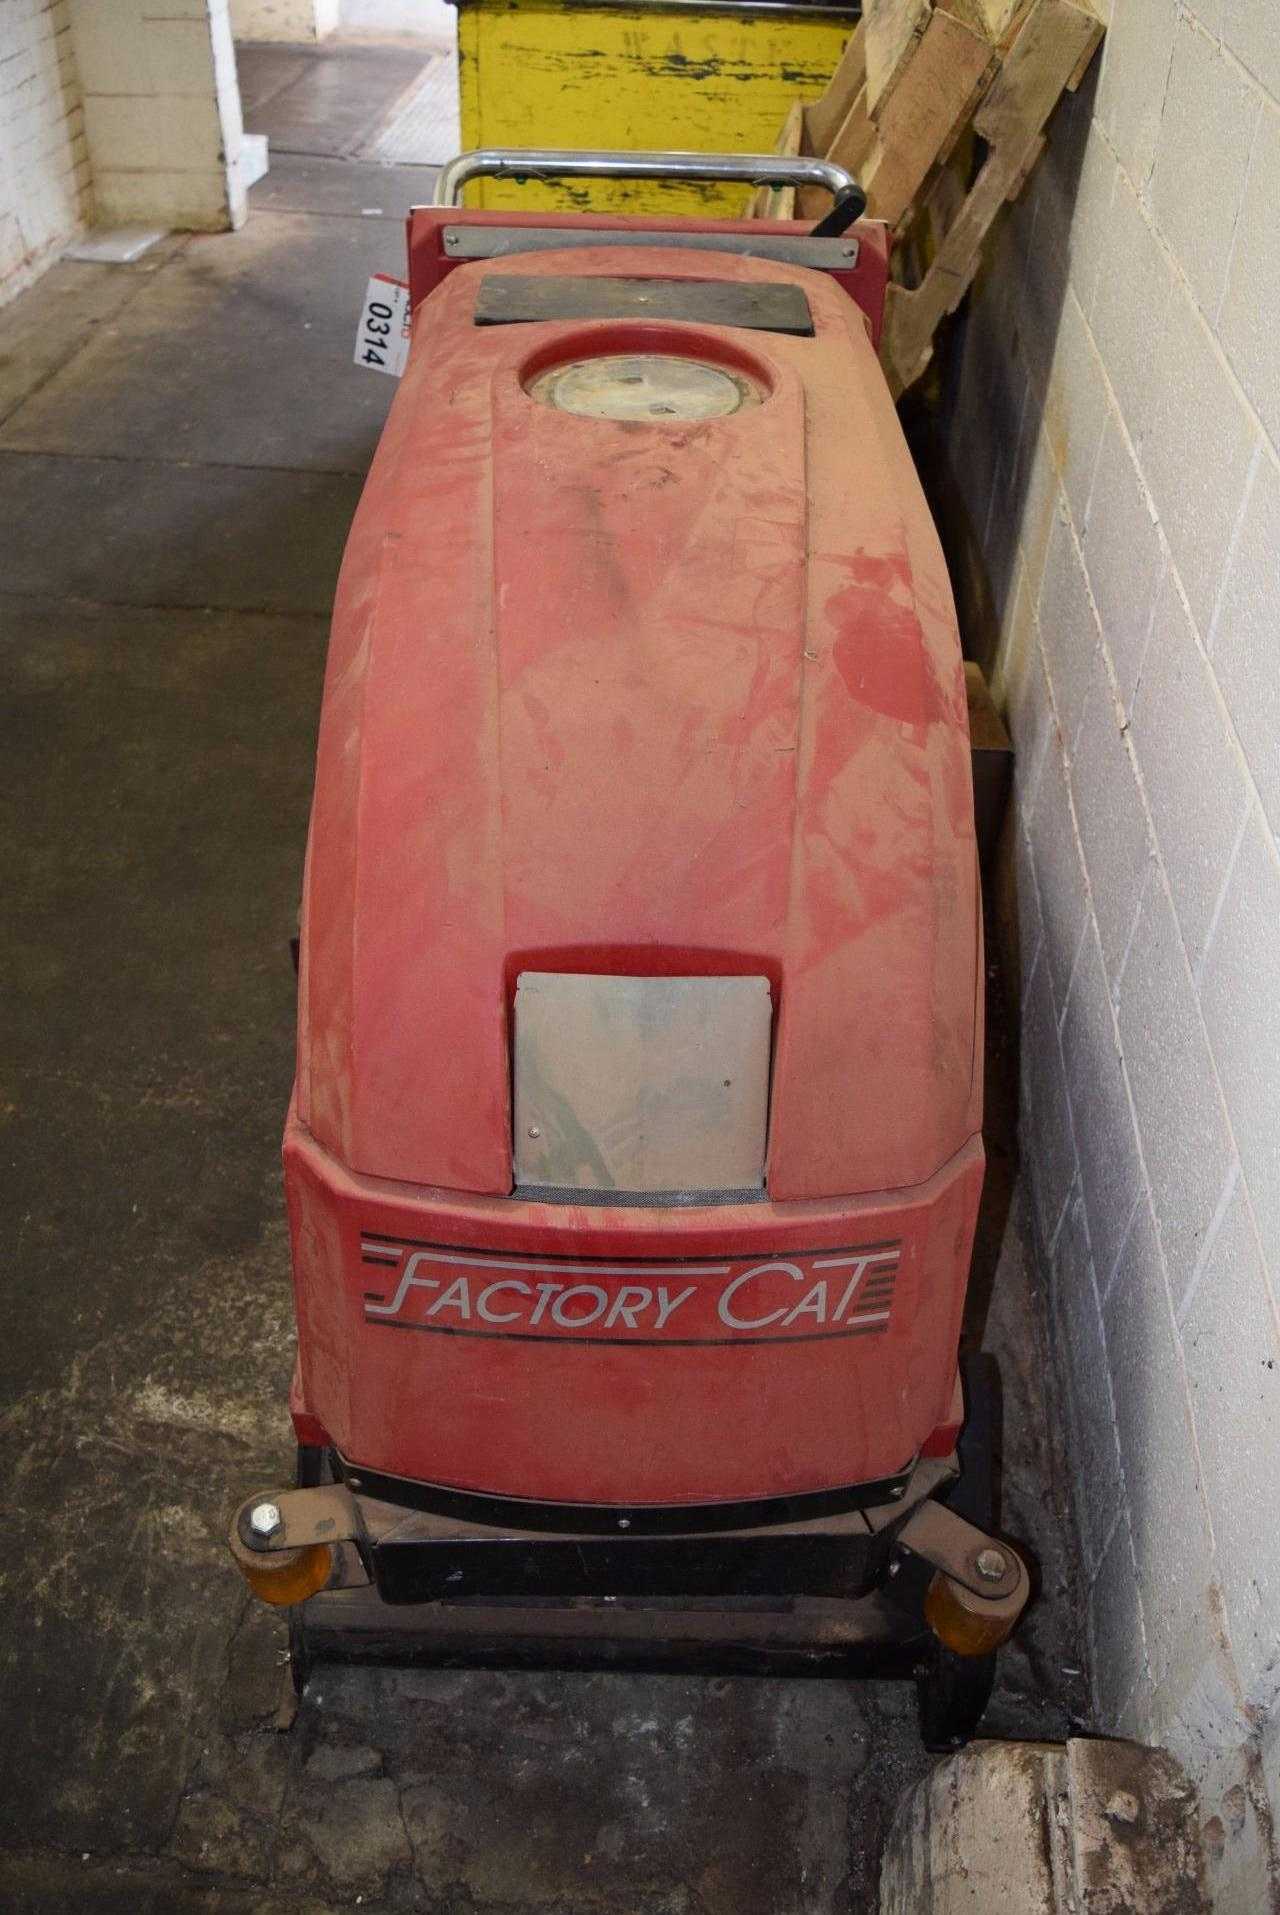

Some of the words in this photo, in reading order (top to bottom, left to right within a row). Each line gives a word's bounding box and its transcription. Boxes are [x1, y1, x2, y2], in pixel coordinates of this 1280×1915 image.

[362, 302, 393, 365] 0314
[364, 1252, 730, 1328] FACTORY
[718, 1251, 900, 1329] CAT
